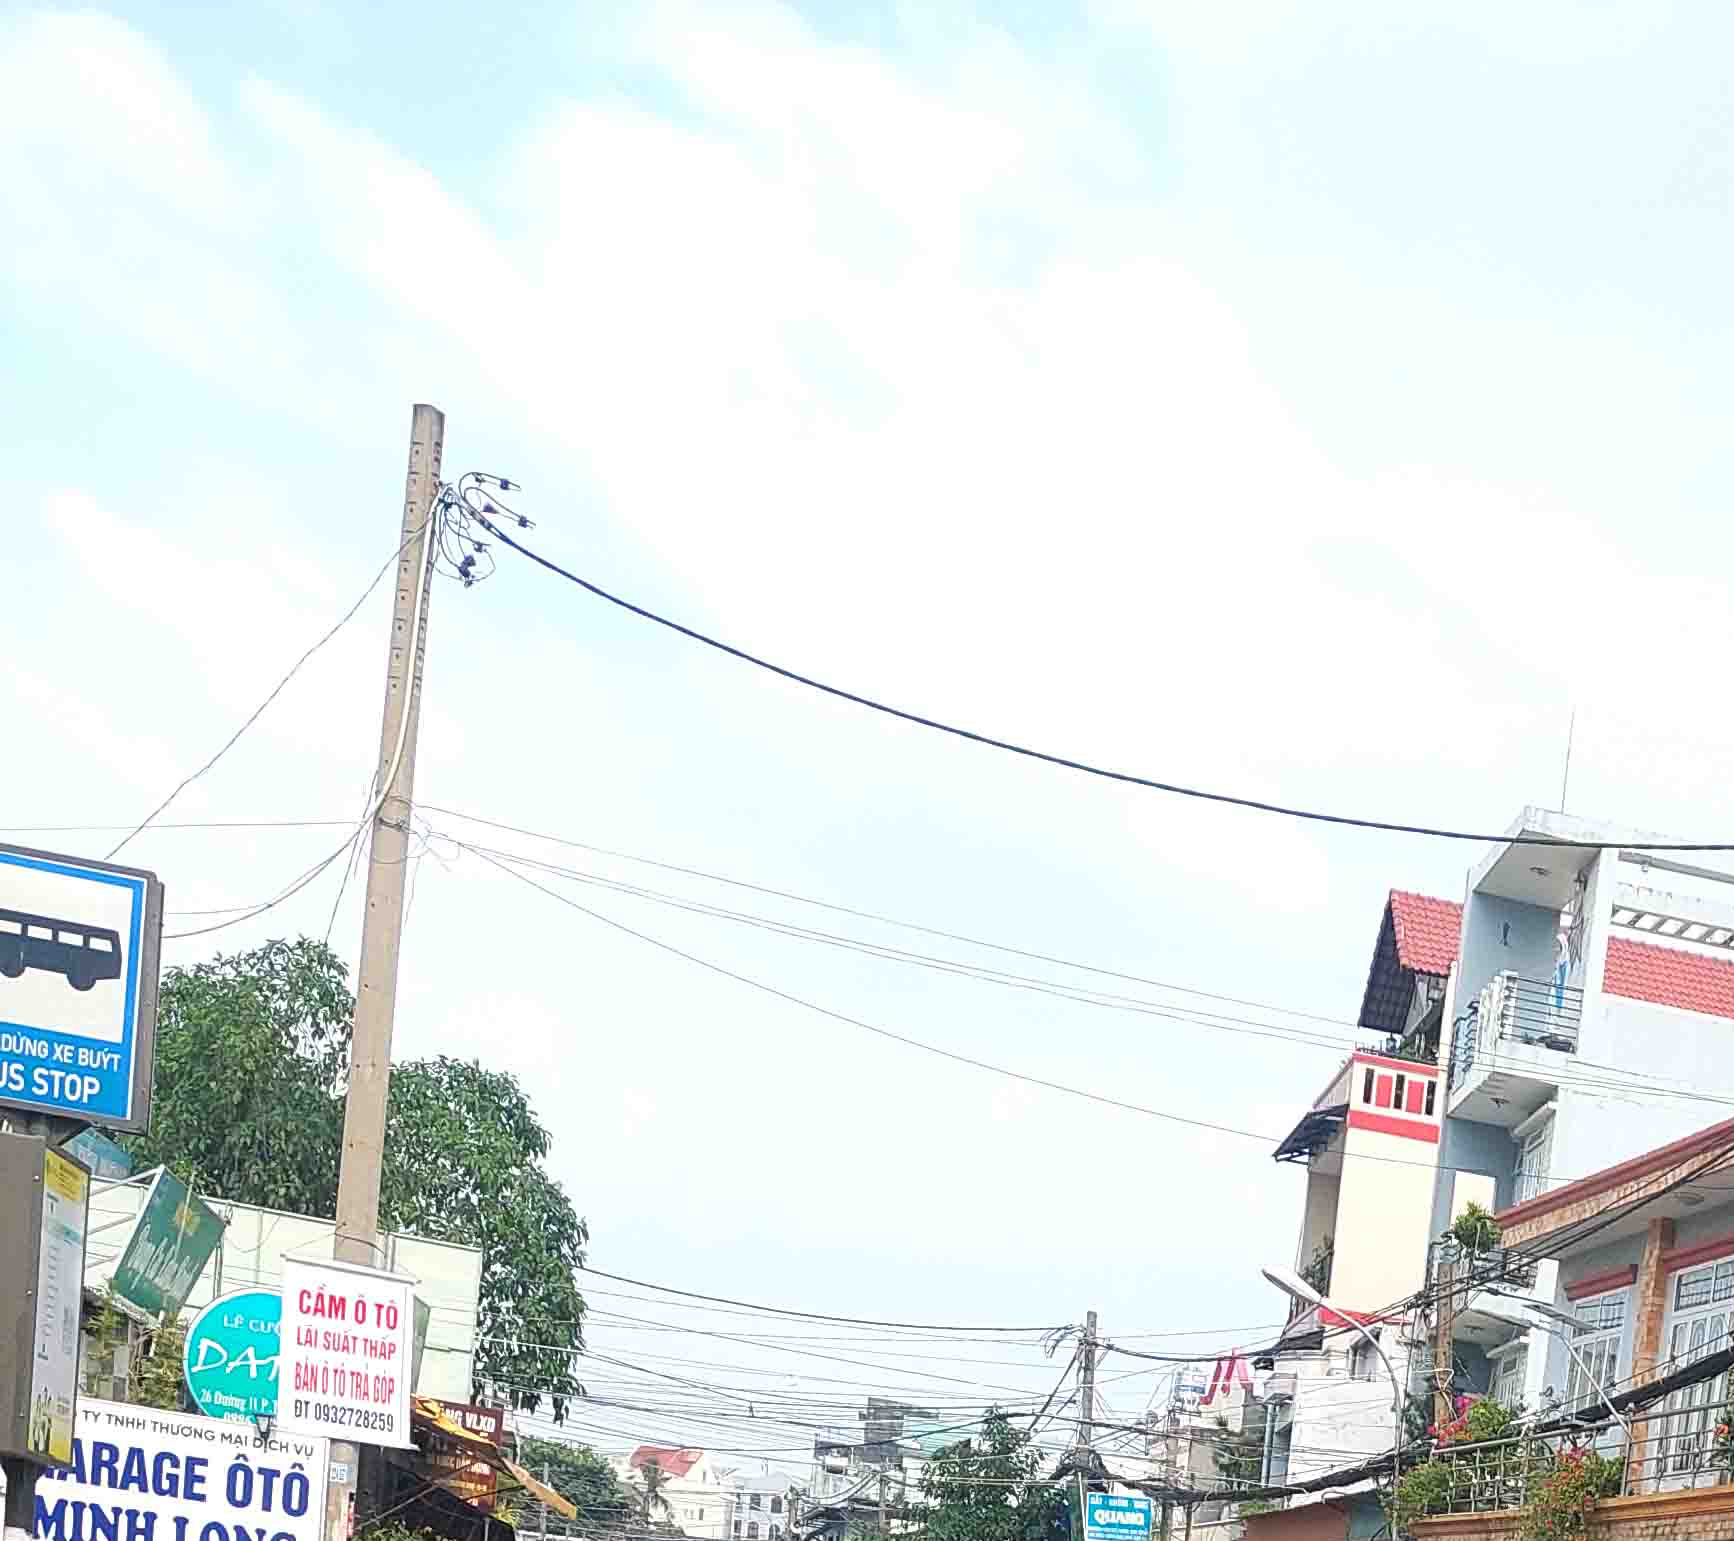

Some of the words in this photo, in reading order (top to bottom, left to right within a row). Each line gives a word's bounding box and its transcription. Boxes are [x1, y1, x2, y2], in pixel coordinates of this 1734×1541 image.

[1, 1032, 48, 1058] DỪNG
[53, 1042, 75, 1064] XE
[78, 1047, 121, 1073] BUÝT
[31, 1067, 100, 1104] STOP
[354, 1294, 367, 1325] Ô
[374, 1300, 398, 1330] TÔ
[321, 1361, 329, 1395] Ô
[333, 1363, 346, 1398] TÔ
[294, 1399, 310, 1418] ĐT
[314, 1403, 394, 1432] 0932728259
[82, 1410, 101, 1423] TY
[107, 1414, 146, 1430] TNHH
[151, 1420, 216, 1442] THƯƠNG
[220, 1433, 248, 1449] MẠI
[294, 1445, 314, 1460] VỤ
[40, 1438, 208, 1502] ARAGE
[226, 1453, 310, 1518] ÔTÔ
